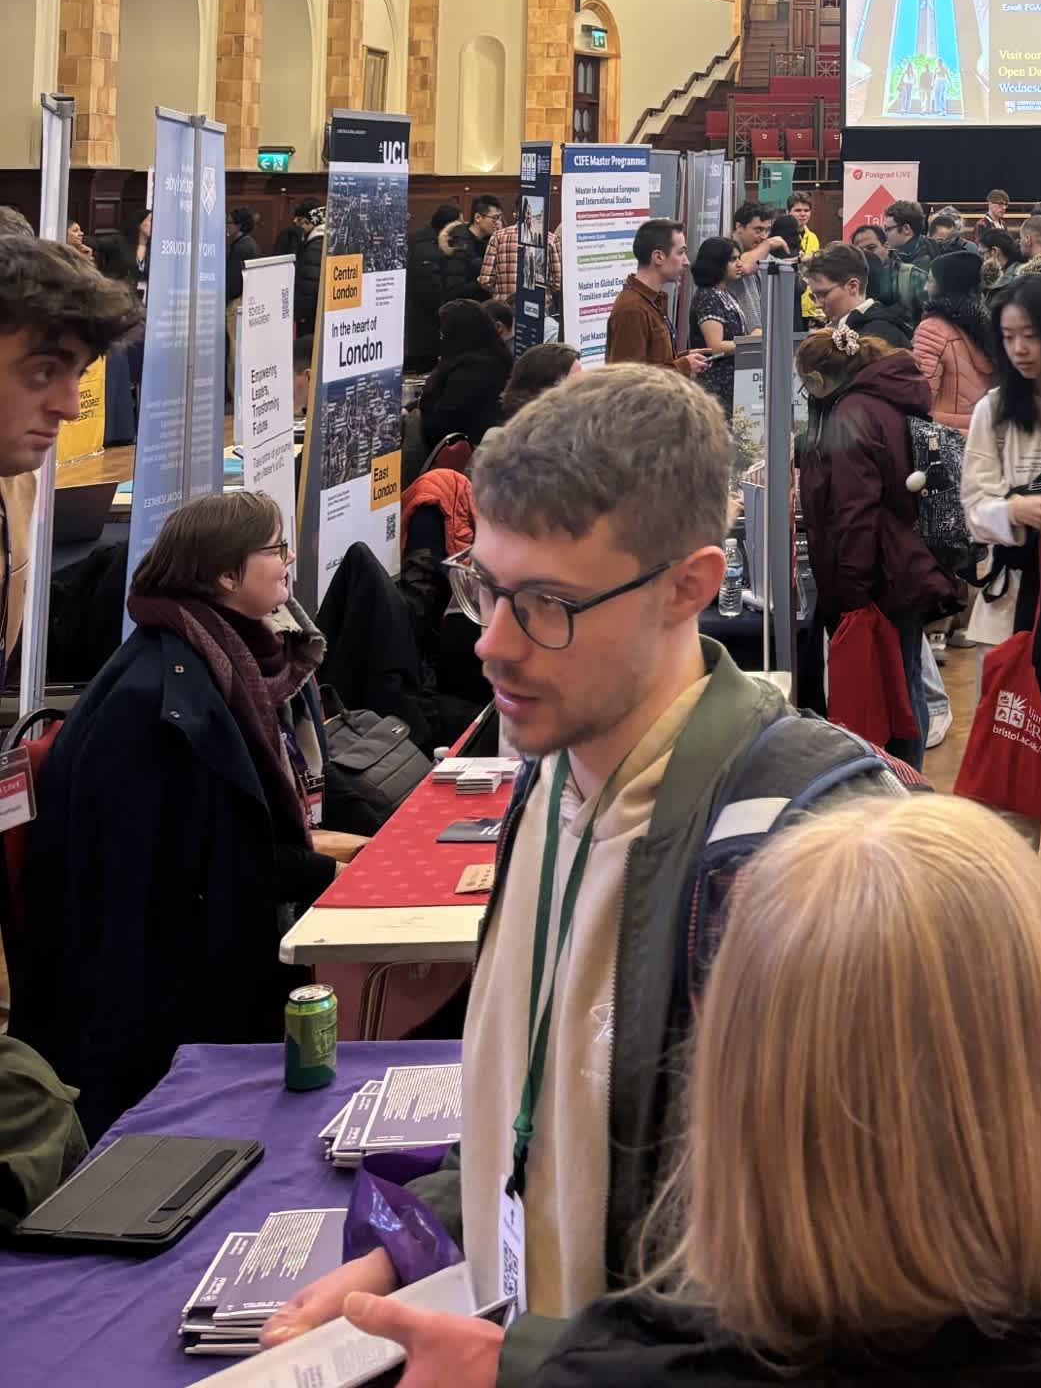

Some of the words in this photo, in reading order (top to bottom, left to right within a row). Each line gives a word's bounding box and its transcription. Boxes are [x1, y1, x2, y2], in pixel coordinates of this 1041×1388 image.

[1000, 50, 1021, 60] Visit
[1024, 52, 1041, 60] our
[998, 66, 1025, 78] Open
[383, 141, 408, 164] UCL
[574, 155, 590, 166] CIFE
[590, 155, 610, 166] Master
[611, 155, 646, 168] Programmes
[865, 171, 895, 179] Postgrad
[575, 186, 591, 195] Master
[597, 184, 618, 193] Advanced
[619, 185, 640, 194] European
[576, 197, 585, 205] and
[585, 196, 615, 205] International
[615, 196, 632, 204] Studies
[864, 214, 882, 226] Tal
[333, 265, 358, 281] Central
[578, 281, 593, 290] Master
[594, 280, 600, 289] in
[600, 279, 614, 288] Global
[333, 284, 357, 300] London
[579, 293, 602, 302] Transition
[332, 323, 338, 337] In
[339, 321, 351, 336] the
[352, 318, 370, 333] heart
[370, 316, 377, 331] of
[339, 336, 383, 367] London
[374, 466, 389, 482] East
[373, 481, 398, 501] London
